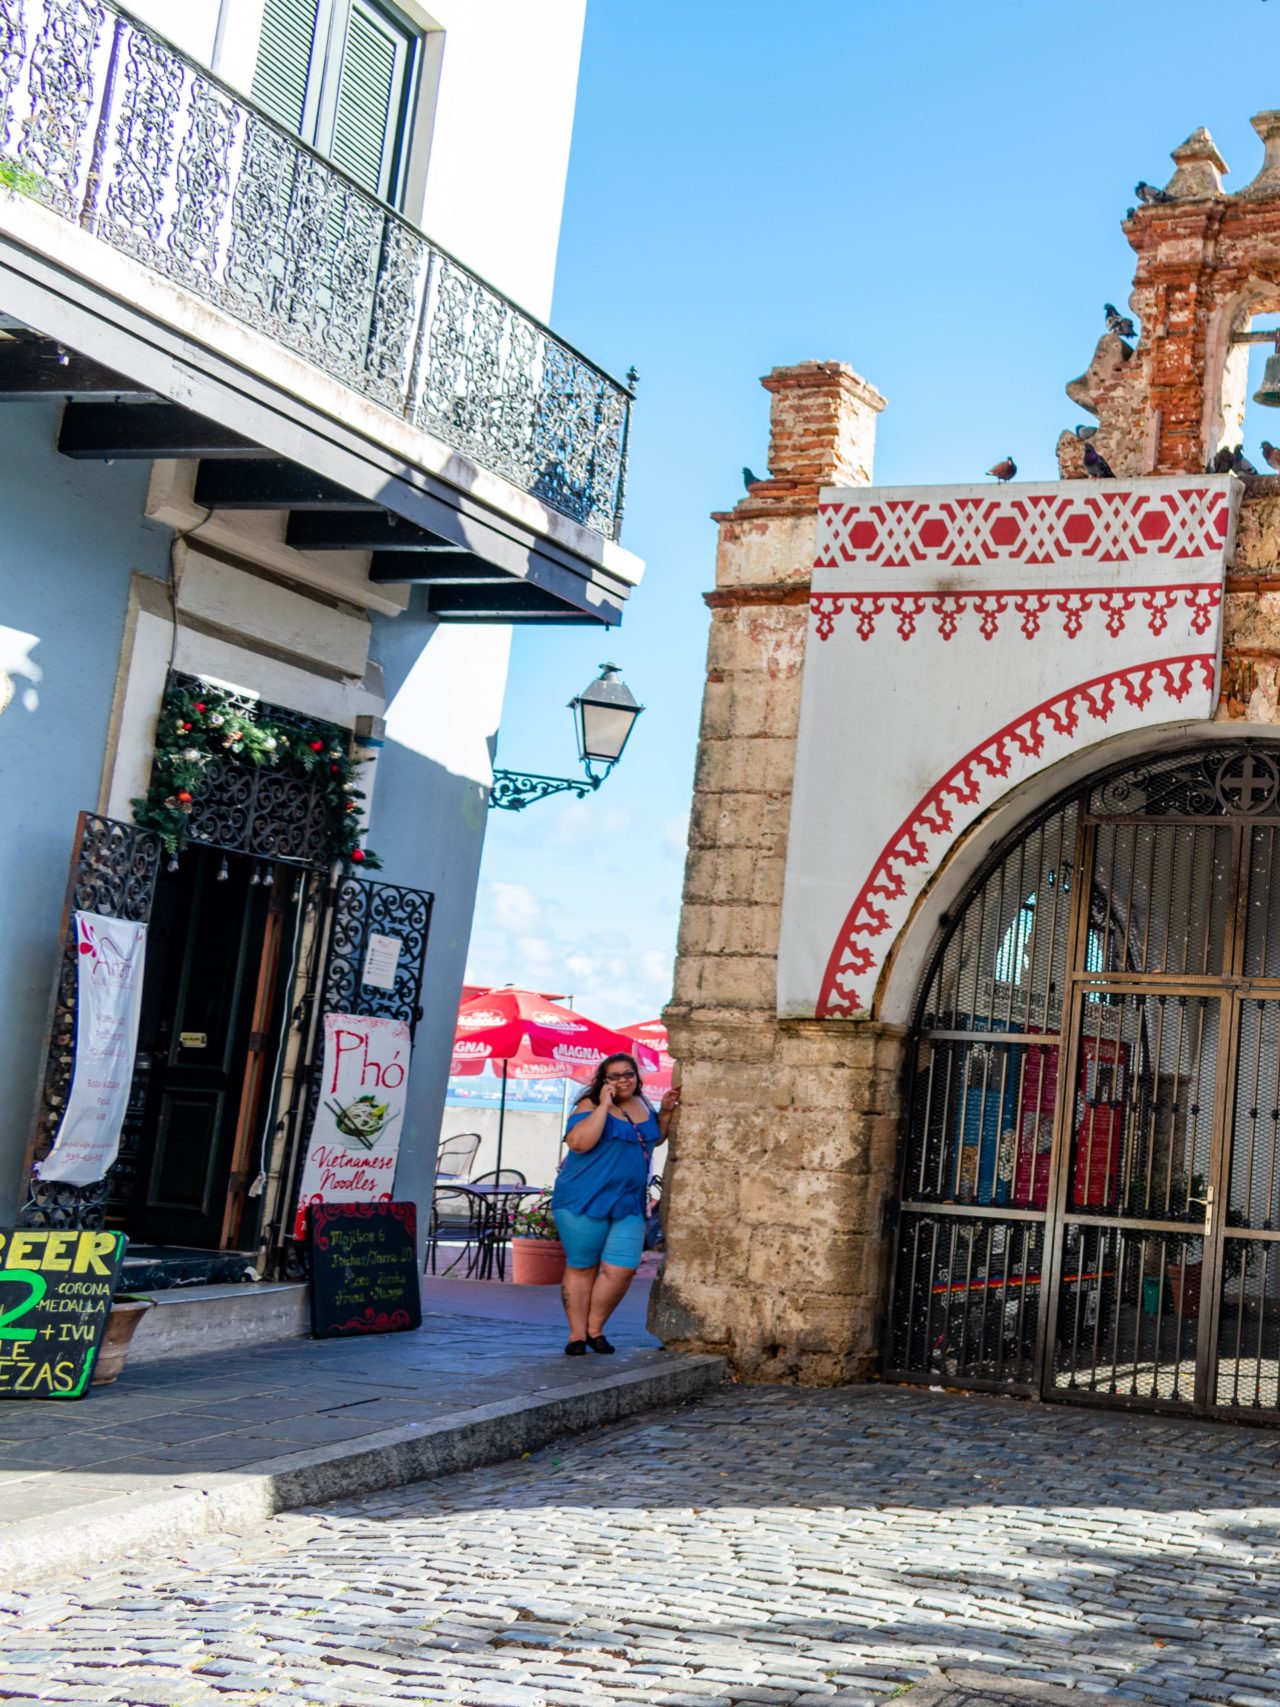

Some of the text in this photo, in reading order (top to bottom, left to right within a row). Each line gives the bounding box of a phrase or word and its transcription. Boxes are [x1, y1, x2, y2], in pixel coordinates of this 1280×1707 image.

[558, 1043, 600, 1058] MAGNA
[311, 1145, 393, 1169] Vietnamese
[320, 1169, 378, 1191] Noodles
[0, 1231, 116, 1275] EER
[58, 1324, 95, 1341] IVU
